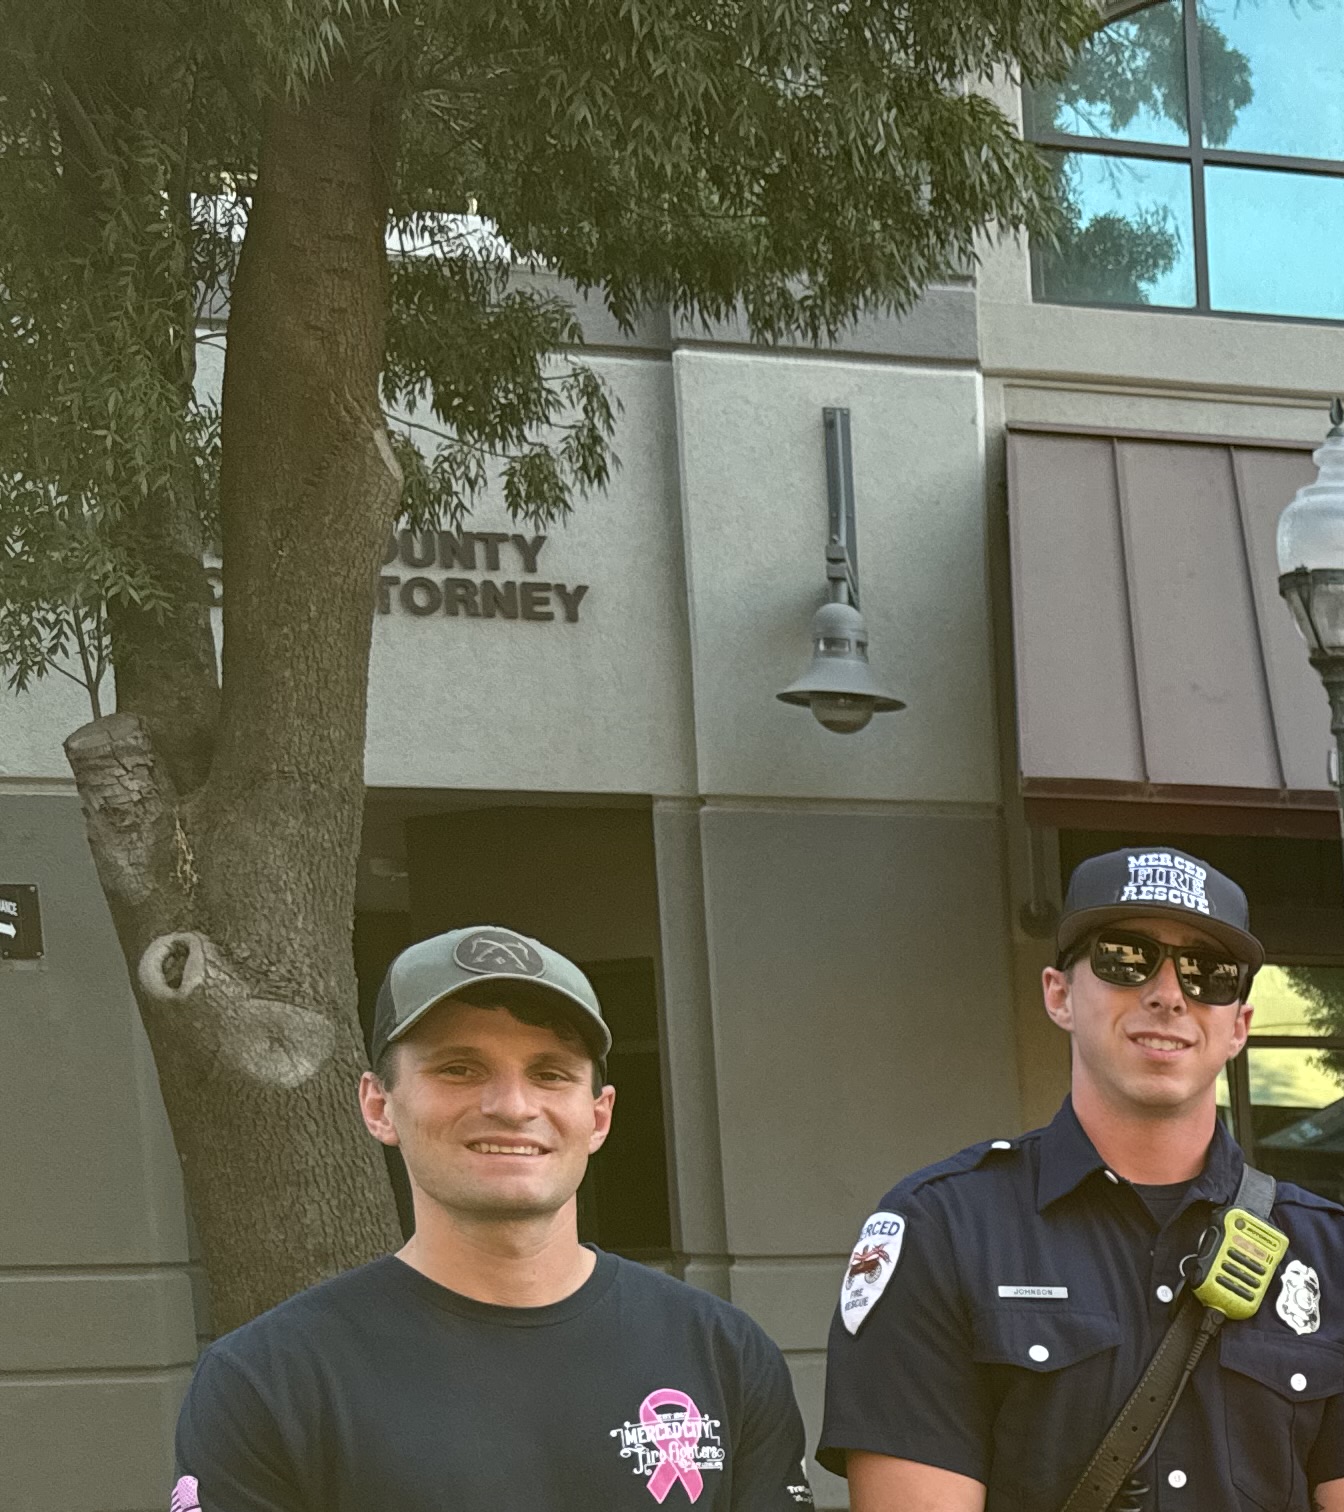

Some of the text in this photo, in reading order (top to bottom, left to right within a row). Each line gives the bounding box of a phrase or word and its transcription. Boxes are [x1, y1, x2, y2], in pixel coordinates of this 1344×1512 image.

[381, 528, 547, 573] OUNTY
[378, 575, 589, 623] TORNEY
[1126, 853, 1207, 881] MERCED
[1127, 866, 1206, 901] FIRE
[1120, 885, 1210, 915] RESCUE
[850, 1288, 864, 1300] FIRE
[1013, 1288, 1053, 1296] JOHNSON
[625, 1420, 713, 1446] MERCED CITY
